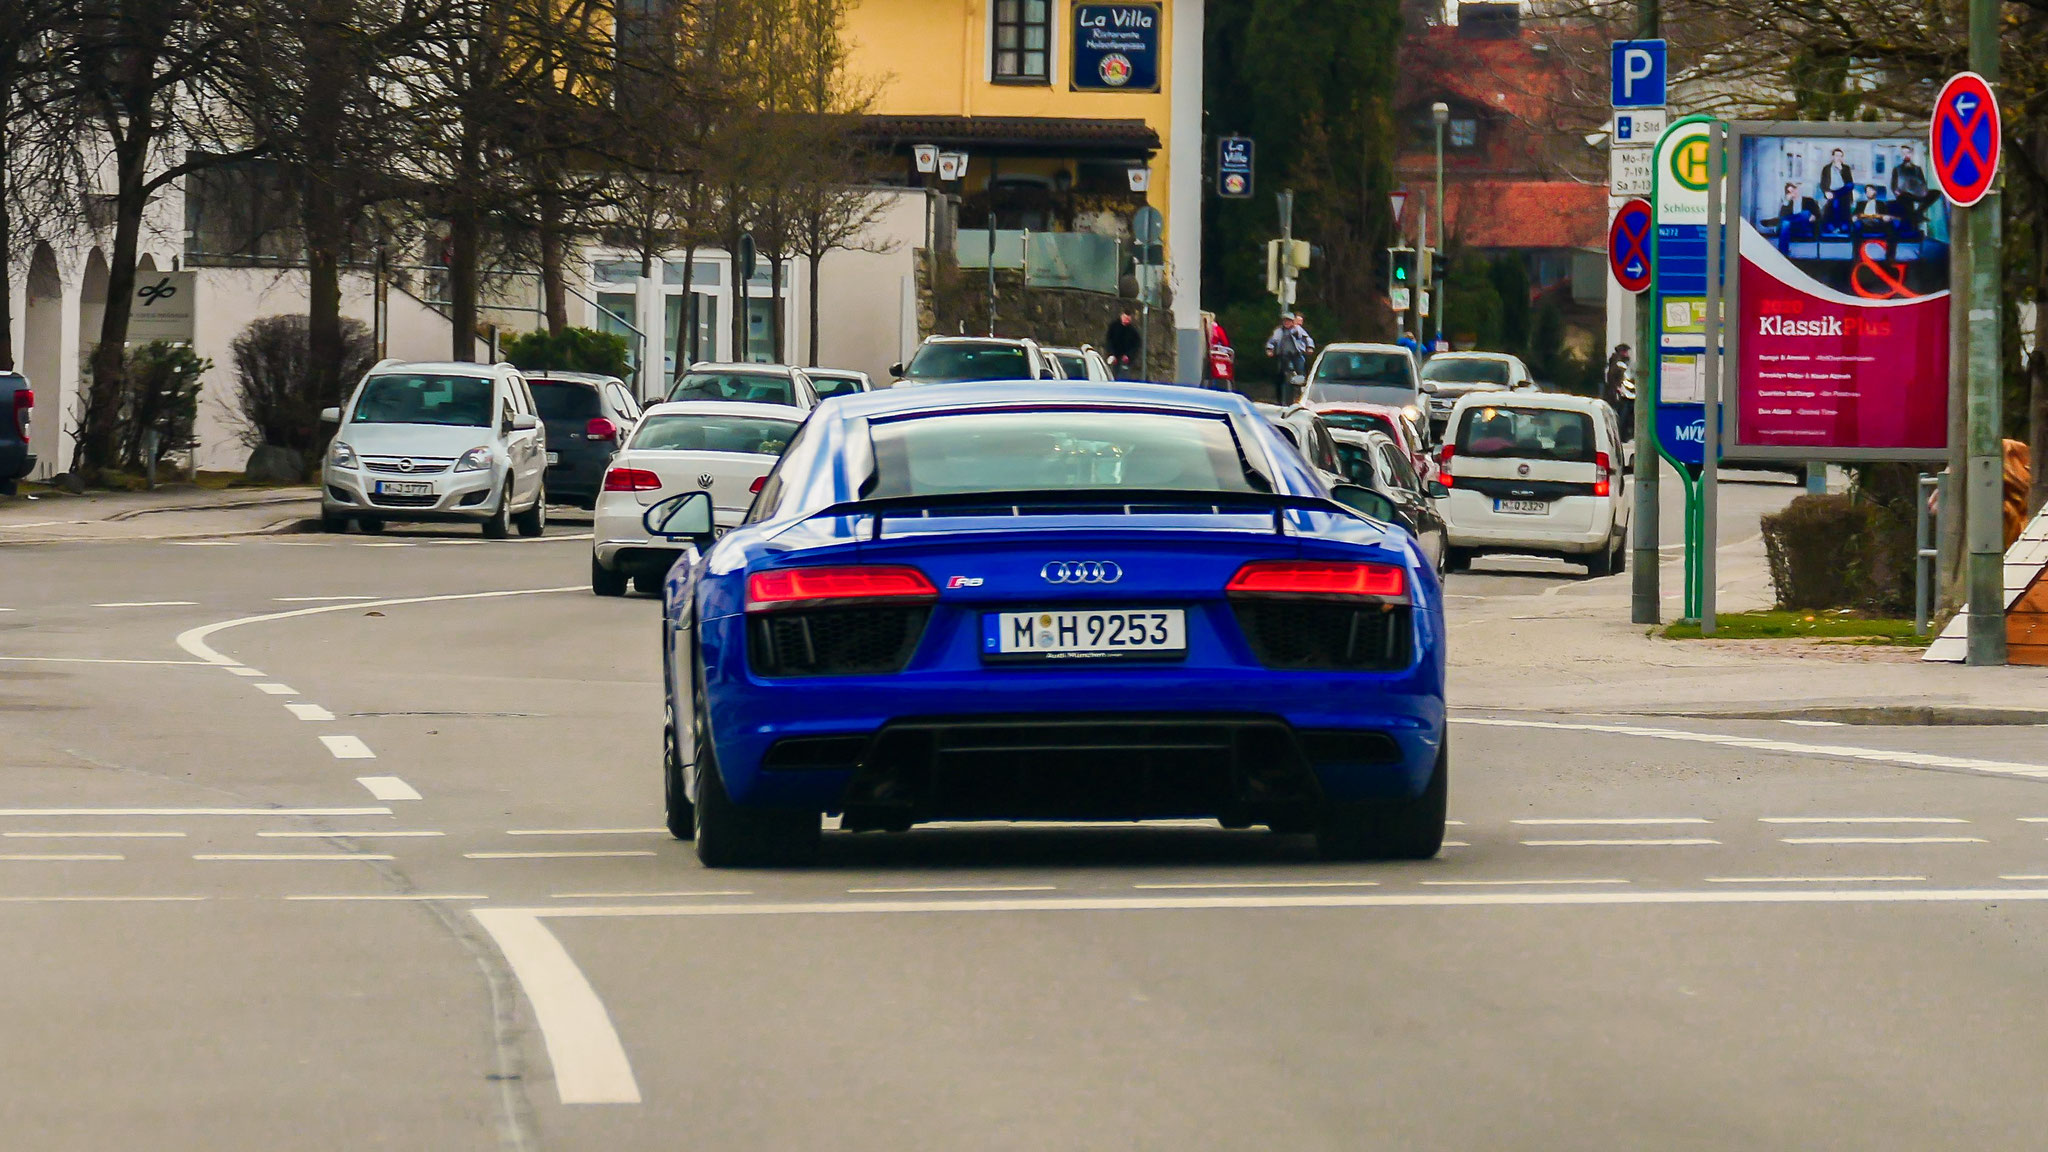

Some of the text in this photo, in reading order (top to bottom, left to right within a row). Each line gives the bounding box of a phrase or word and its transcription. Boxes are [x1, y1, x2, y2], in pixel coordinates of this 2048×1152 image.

[1080, 8, 1152, 27] La Villa
[1624, 49, 1653, 98] P
[1635, 121, 1660, 133] 2 Std
[1229, 139, 1244, 151] La
[1224, 151, 1248, 163] Villa
[1688, 147, 1709, 178] H
[1624, 167, 1643, 177] 7-19
[1617, 181, 1628, 191] Sa
[1850, 239, 1924, 300] &
[1014, 614, 1168, 648] M H 9253
